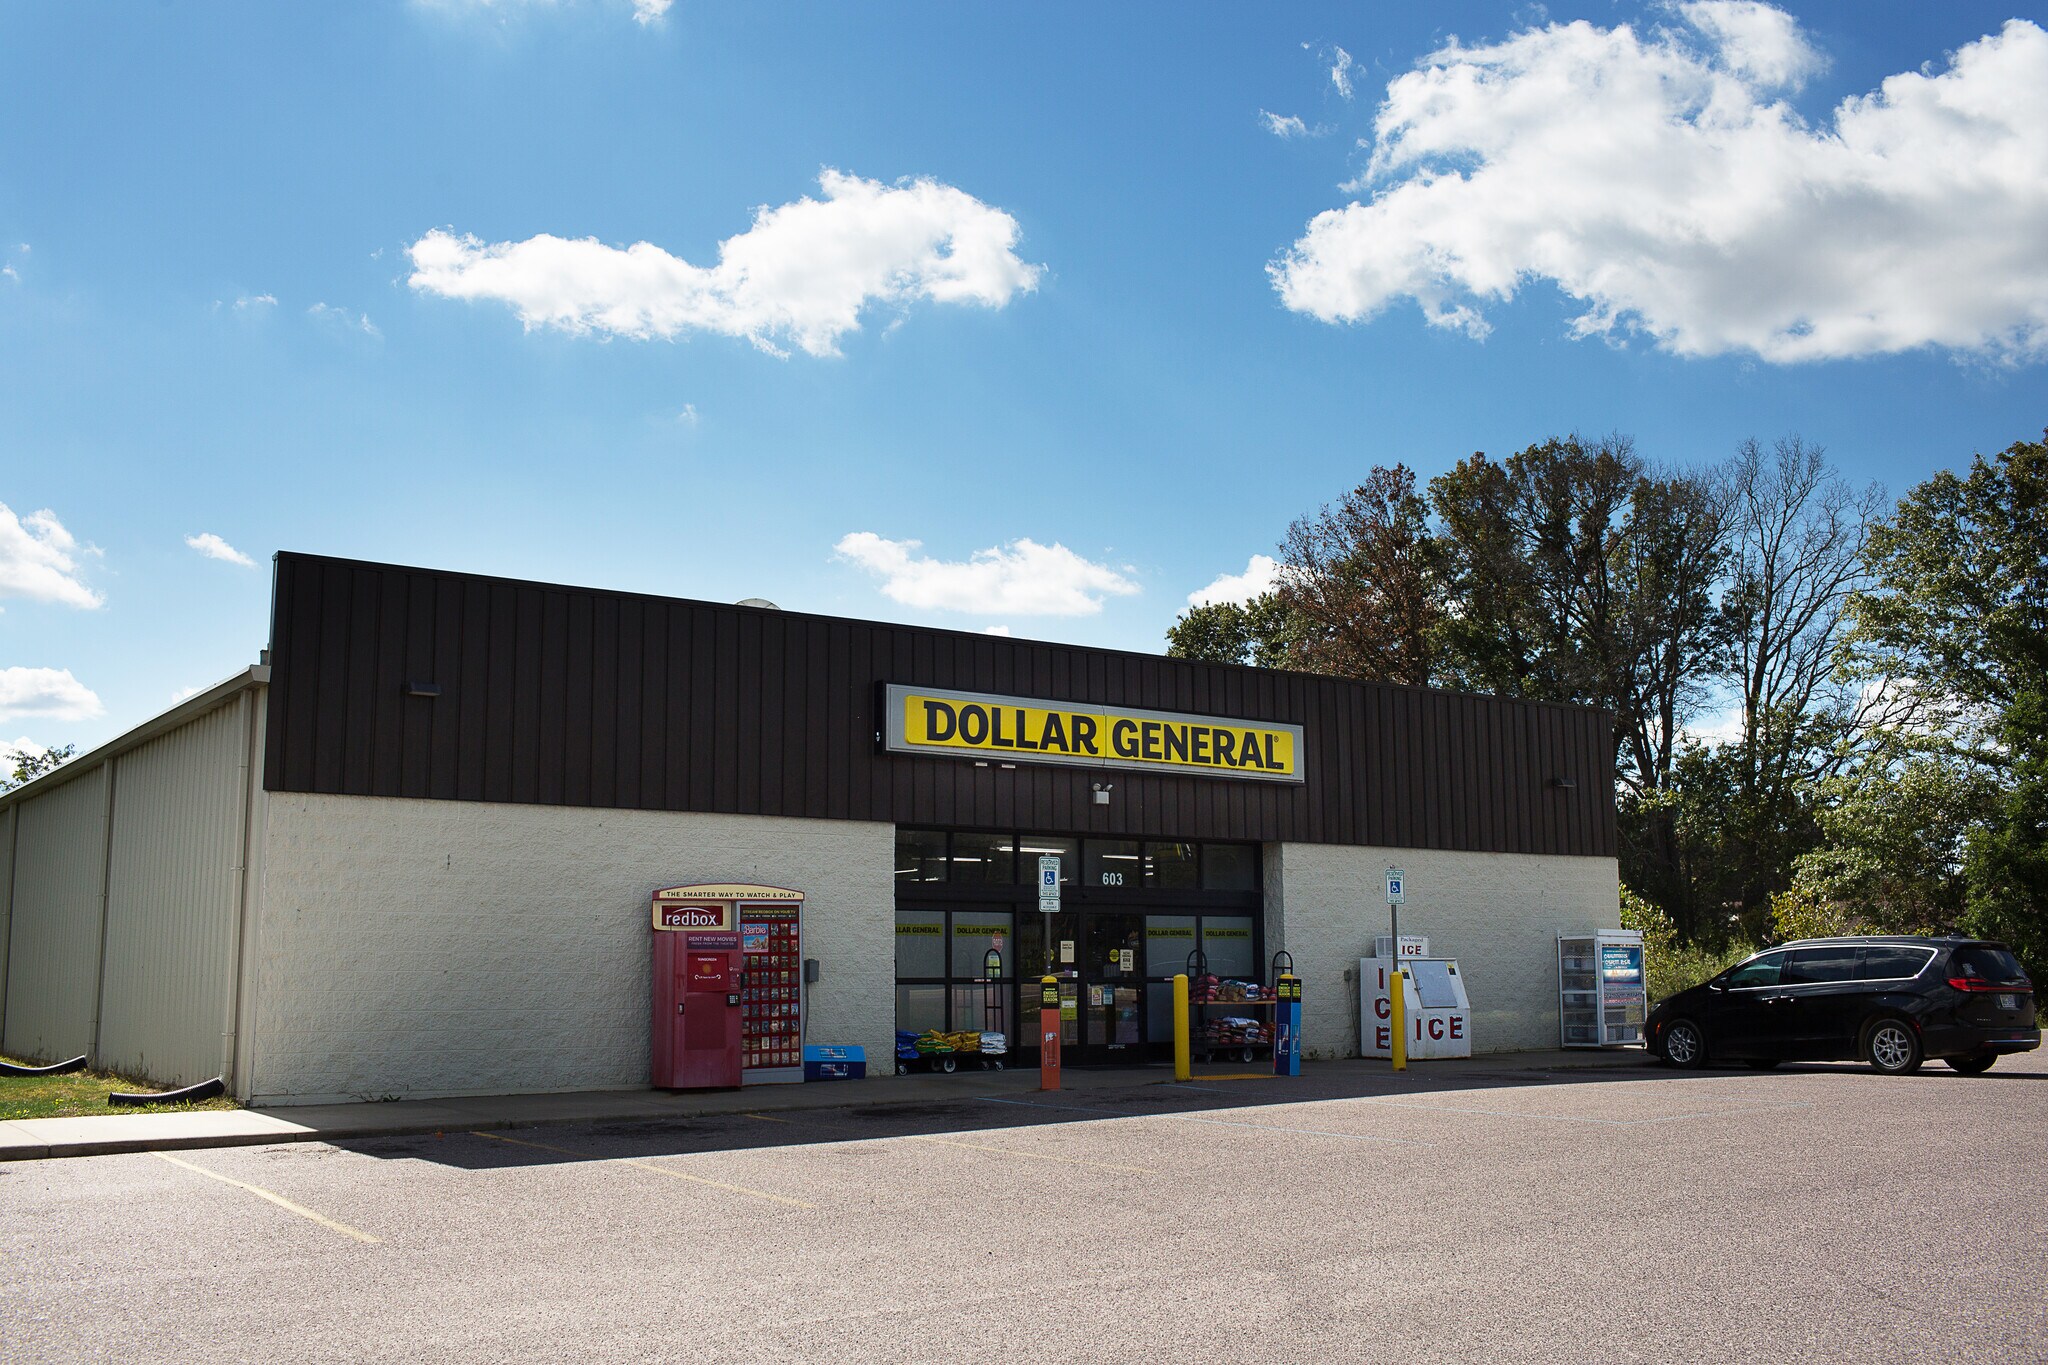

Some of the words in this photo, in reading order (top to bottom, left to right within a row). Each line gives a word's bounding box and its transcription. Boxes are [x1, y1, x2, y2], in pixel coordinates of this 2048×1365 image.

[924, 701, 1098, 754] DOLLAR
[1112, 719, 1284, 770] GENERAL
[1102, 872, 1123, 886] 603
[666, 911, 717, 926] redbox
[743, 923, 767, 935] Barbie
[912, 926, 940, 934] GENERAL
[1401, 945, 1422, 955] ICE
[1374, 965, 1390, 1050] ICE
[1415, 1013, 1463, 1040] ICE
